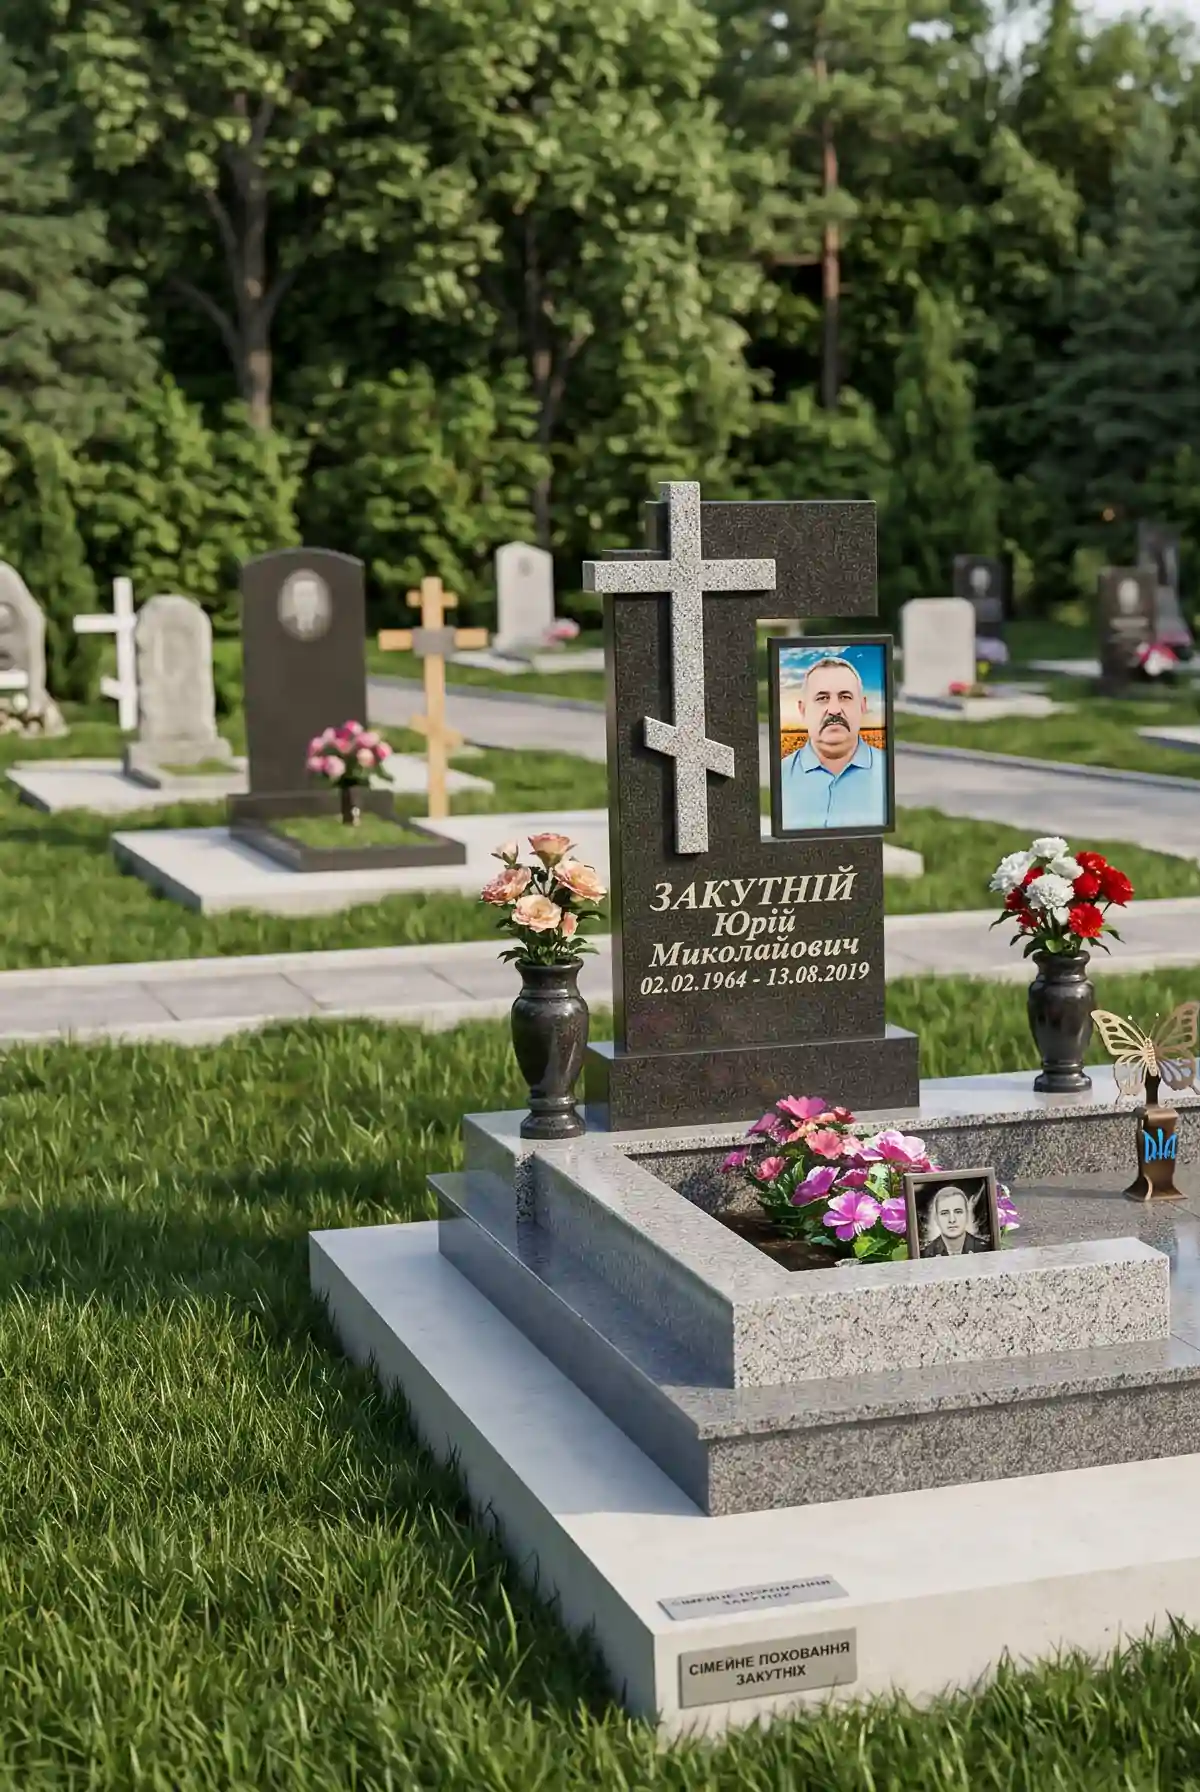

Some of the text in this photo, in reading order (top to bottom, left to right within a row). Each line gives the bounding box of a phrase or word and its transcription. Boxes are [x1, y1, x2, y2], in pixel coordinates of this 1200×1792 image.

[649, 864, 858, 912] ЗАКУТНІЙ
[712, 907, 795, 941] Юрій
[648, 935, 859, 968] Миколайович
[640, 970, 746, 995] 02.02.1964
[766, 961, 870, 987] 13.08.2019
[689, 1641, 850, 1676] СІМЕЙНЕ ПОХОВАННЯ
[736, 1664, 807, 1686] ЗАКУТНІХ
